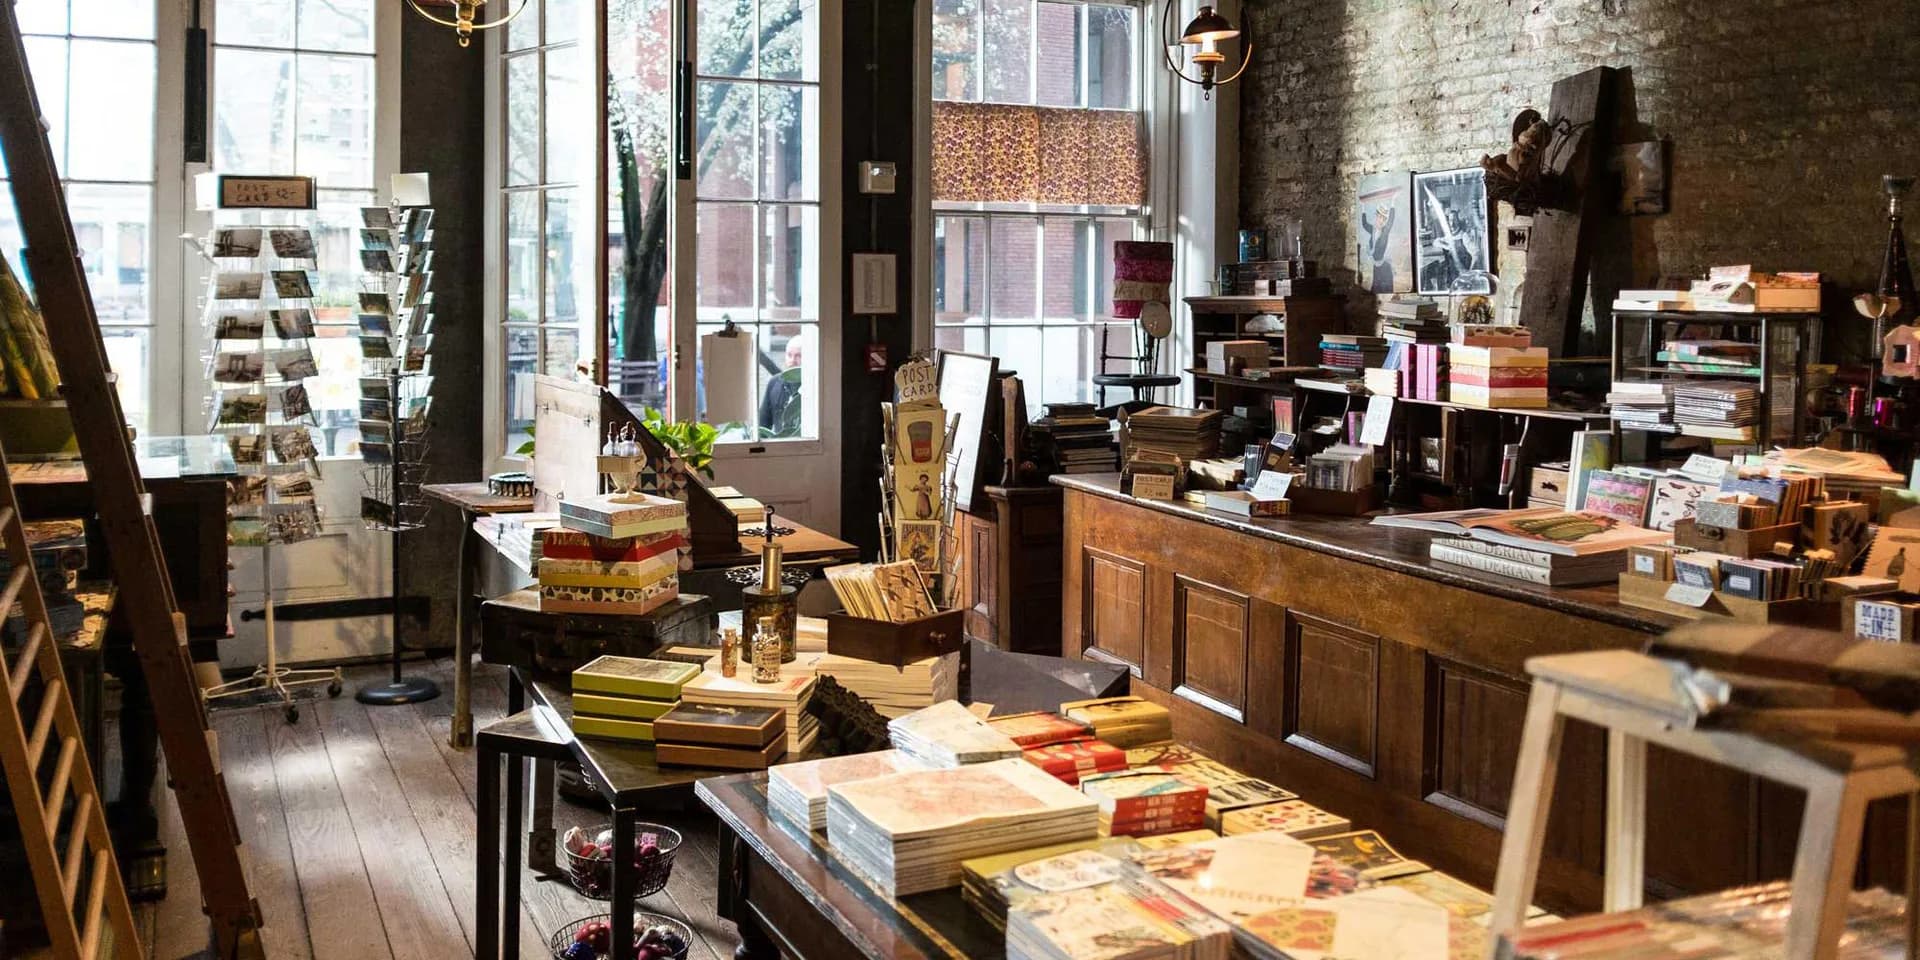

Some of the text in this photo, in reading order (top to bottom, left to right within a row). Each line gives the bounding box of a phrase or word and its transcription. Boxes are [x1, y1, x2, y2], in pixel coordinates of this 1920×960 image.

[902, 365, 931, 386] POST
[903, 383, 934, 398] CARD
[1485, 544, 1535, 563] DERIAN
[1441, 551, 1535, 581] JOHN DERIAN
[1862, 604, 1895, 622] MADE
[1872, 619, 1883, 635] IN
